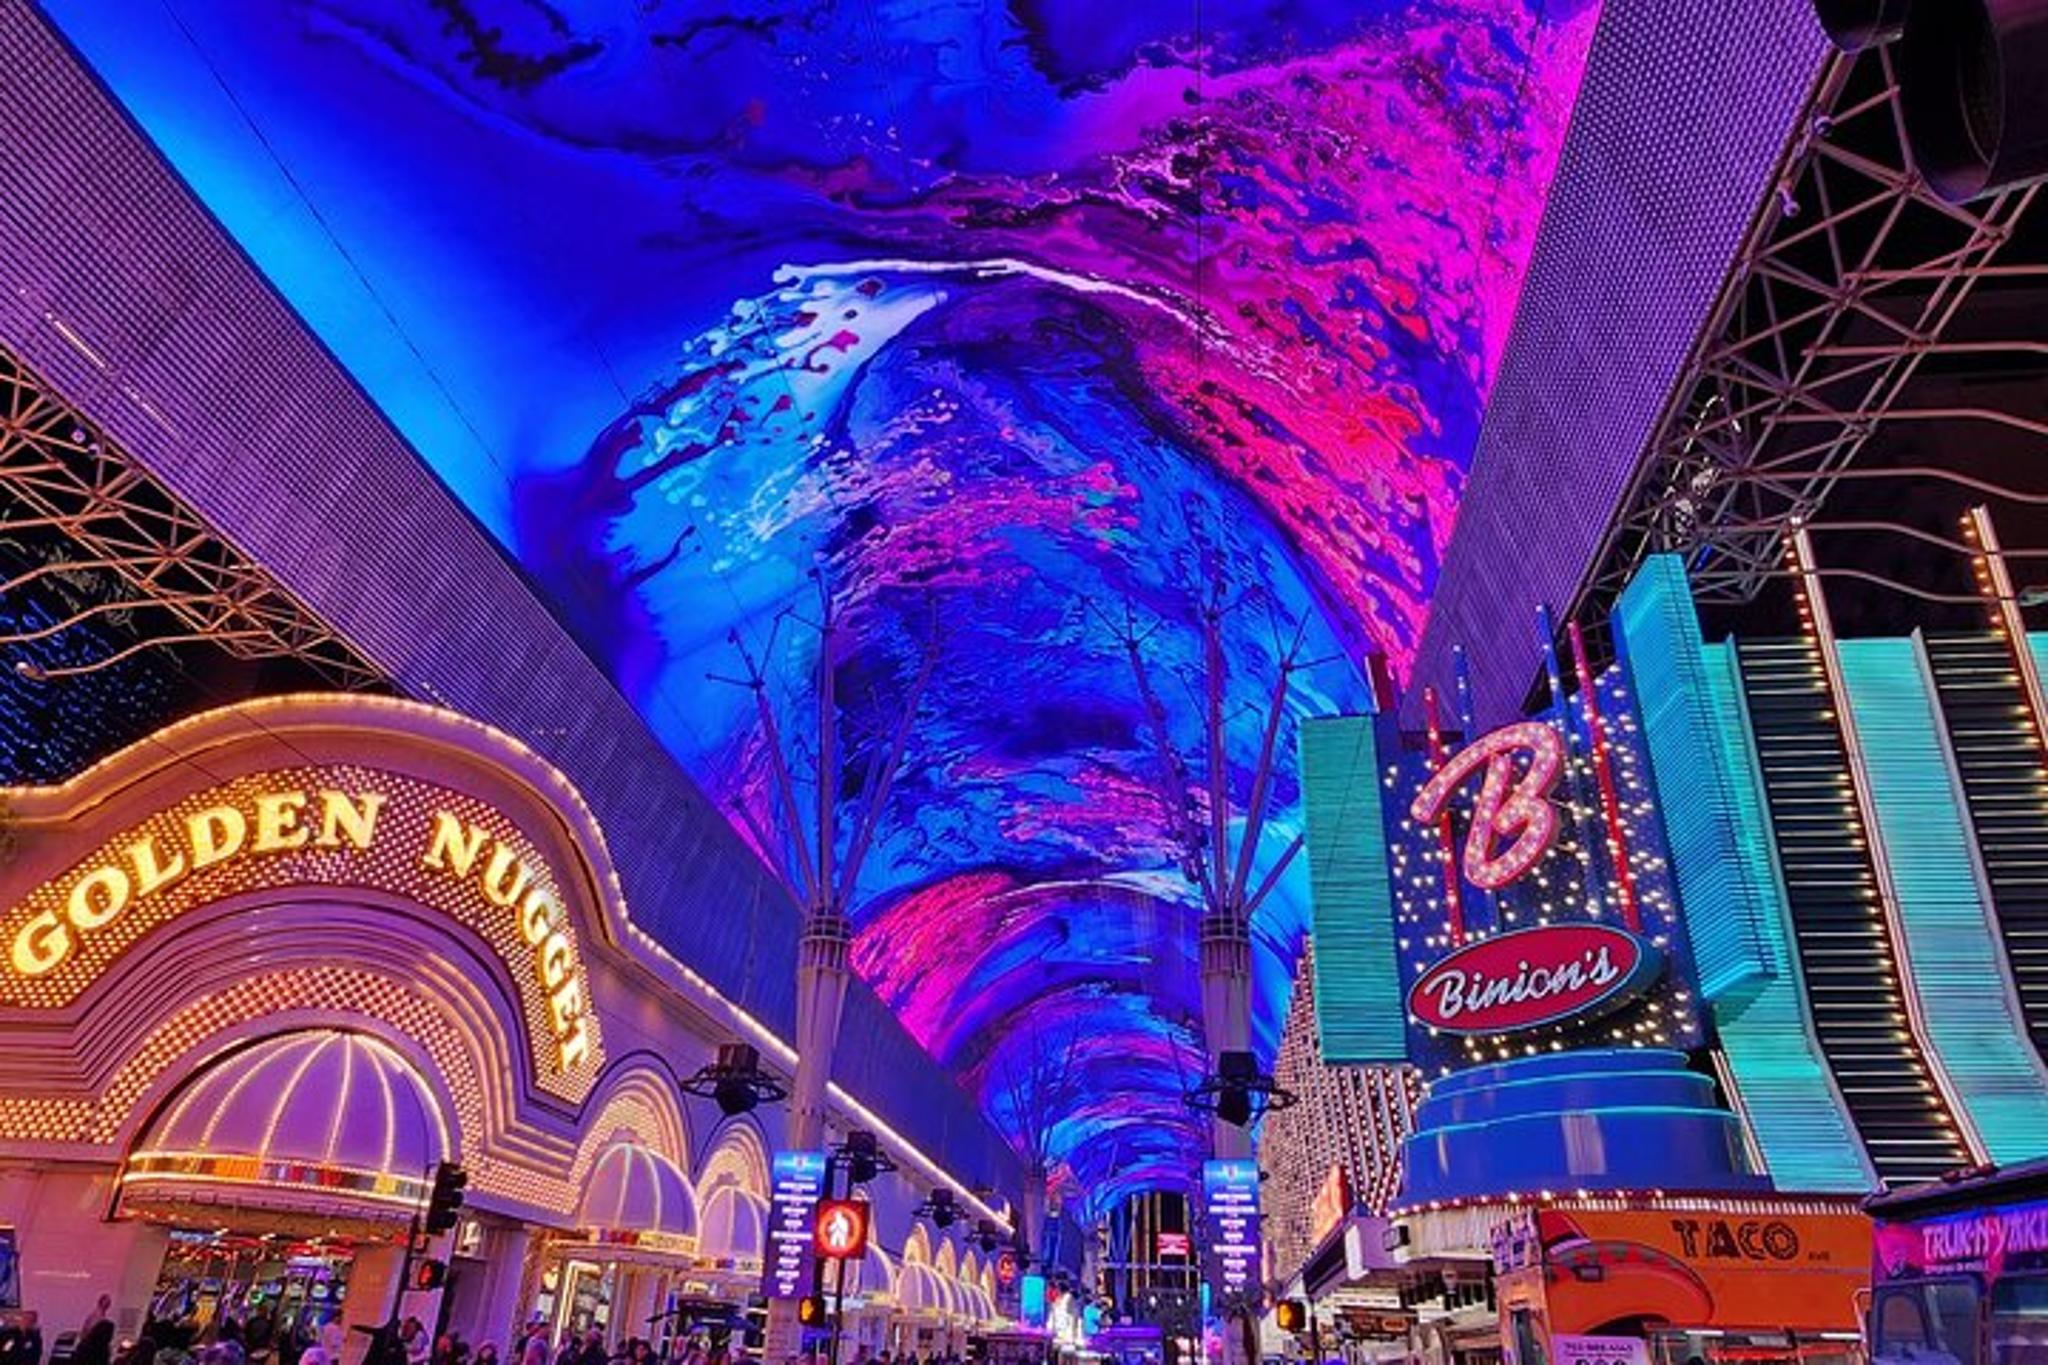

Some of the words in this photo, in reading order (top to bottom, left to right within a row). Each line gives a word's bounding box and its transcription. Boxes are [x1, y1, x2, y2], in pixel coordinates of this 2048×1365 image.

[1410, 722, 1563, 889] B
[11, 789, 388, 975] GOLDEN
[422, 809, 592, 1073] NUGGET
[1424, 947, 1618, 1019] Binion's
[1671, 1219, 1798, 1261] TACO
